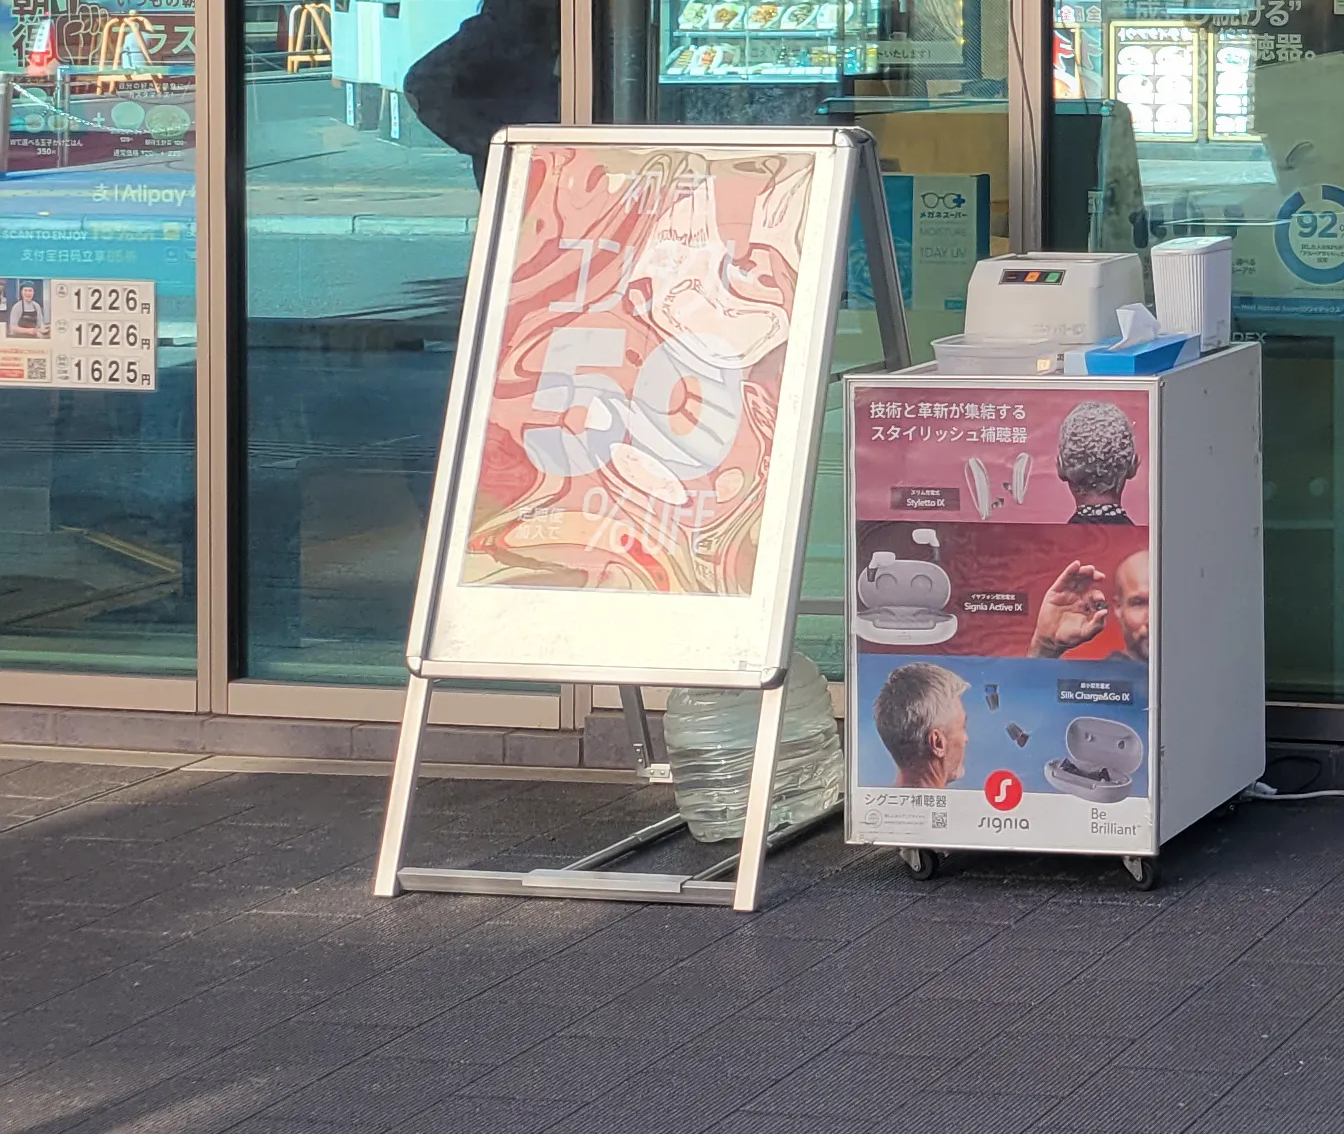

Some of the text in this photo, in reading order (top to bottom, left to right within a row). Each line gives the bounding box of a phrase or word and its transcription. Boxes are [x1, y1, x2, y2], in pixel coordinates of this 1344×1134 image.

[120, 183, 188, 206] Alipay
[919, 211, 967, 219] メガネスーパー
[521, 326, 746, 482] 50
[869, 401, 1027, 421] 技術と革新が集結する
[871, 425, 1028, 444] スタイリッシュ補聴器
[906, 497, 936, 509] Styletto
[963, 601, 989, 614] Signia
[989, 602, 1014, 613] Active
[1074, 690, 1121, 702] Charge&Go
[864, 792, 948, 809] シグニア補聴器
[1090, 807, 1108, 820] Be
[977, 815, 1031, 834] signia
